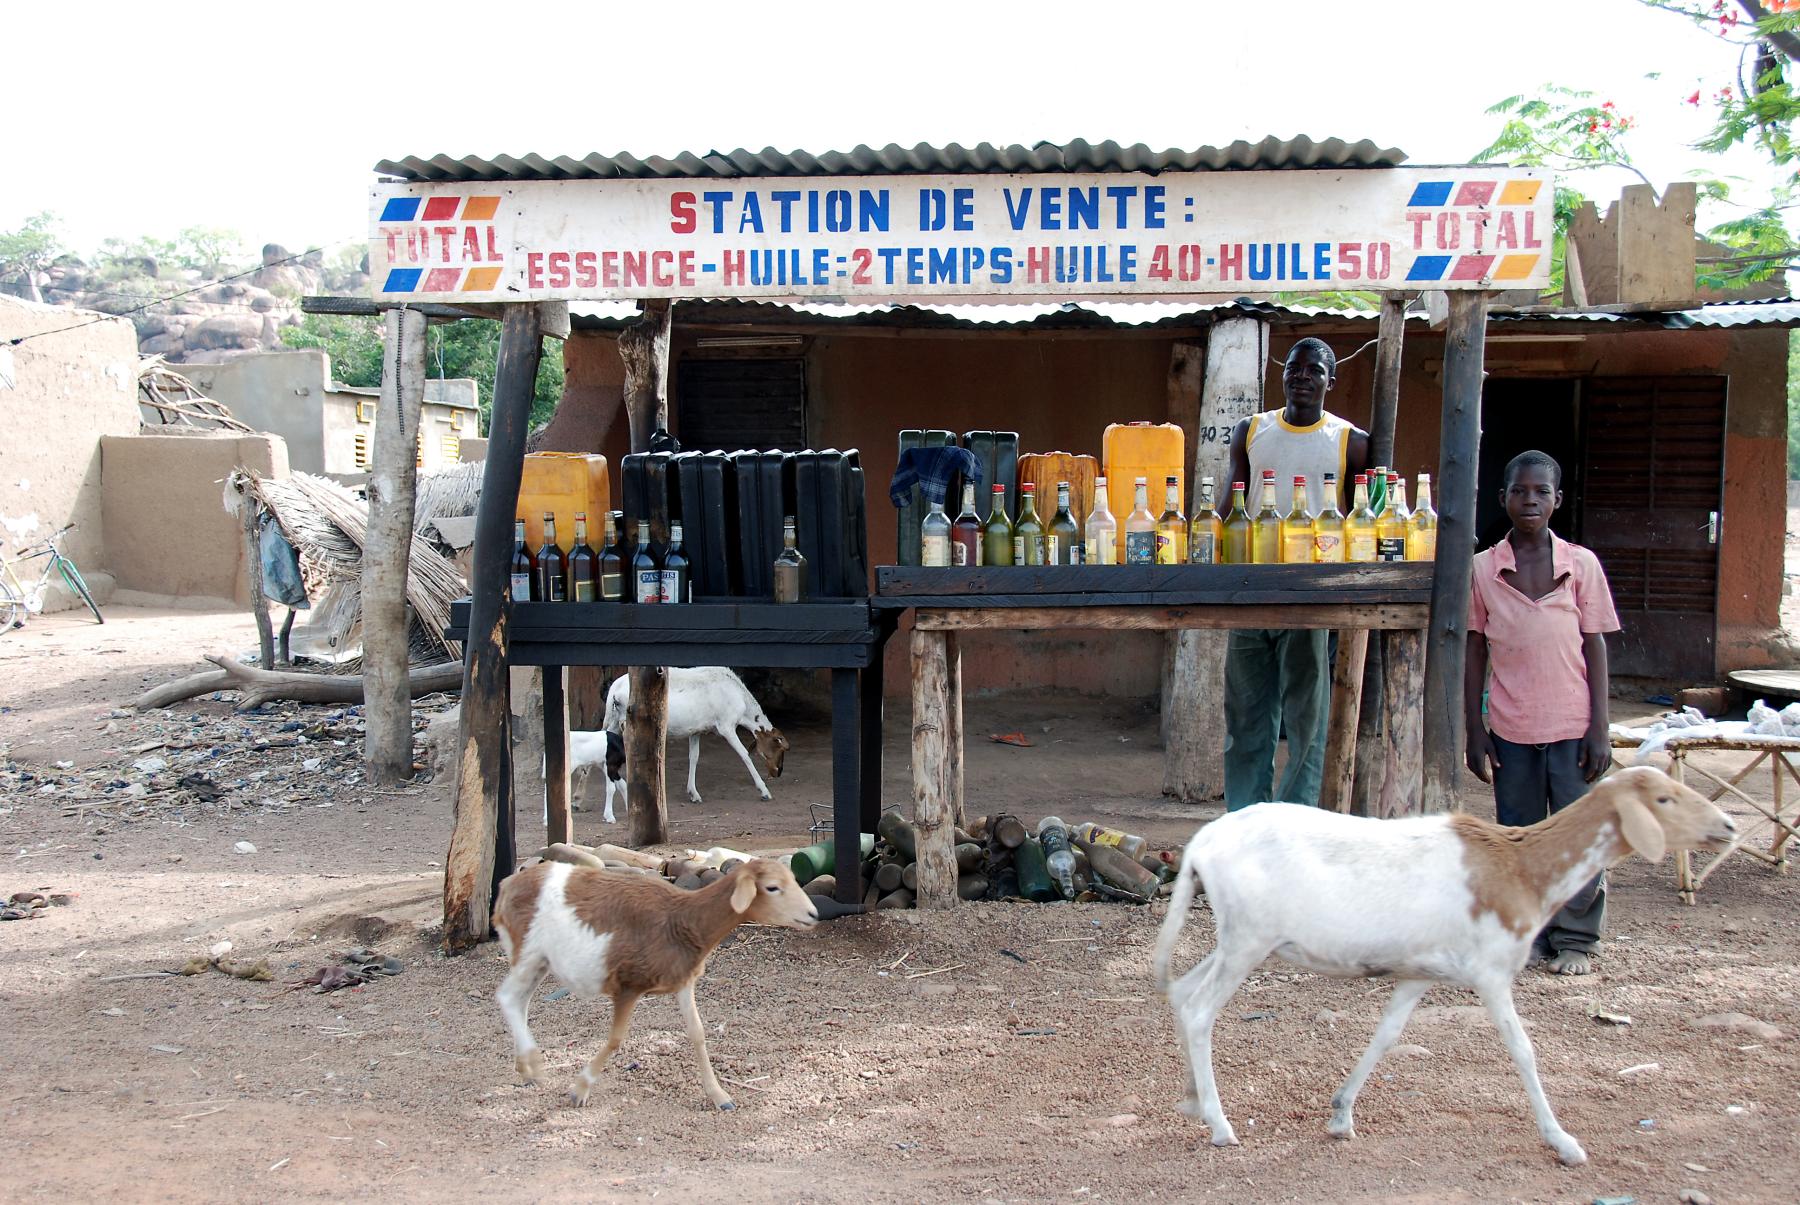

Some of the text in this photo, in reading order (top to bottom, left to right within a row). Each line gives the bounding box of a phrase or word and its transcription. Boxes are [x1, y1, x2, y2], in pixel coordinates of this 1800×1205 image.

[671, 190, 890, 235] STATION
[919, 188, 974, 231] DE
[1405, 210, 1542, 250] TOTAL
[378, 225, 504, 263] TOTAL
